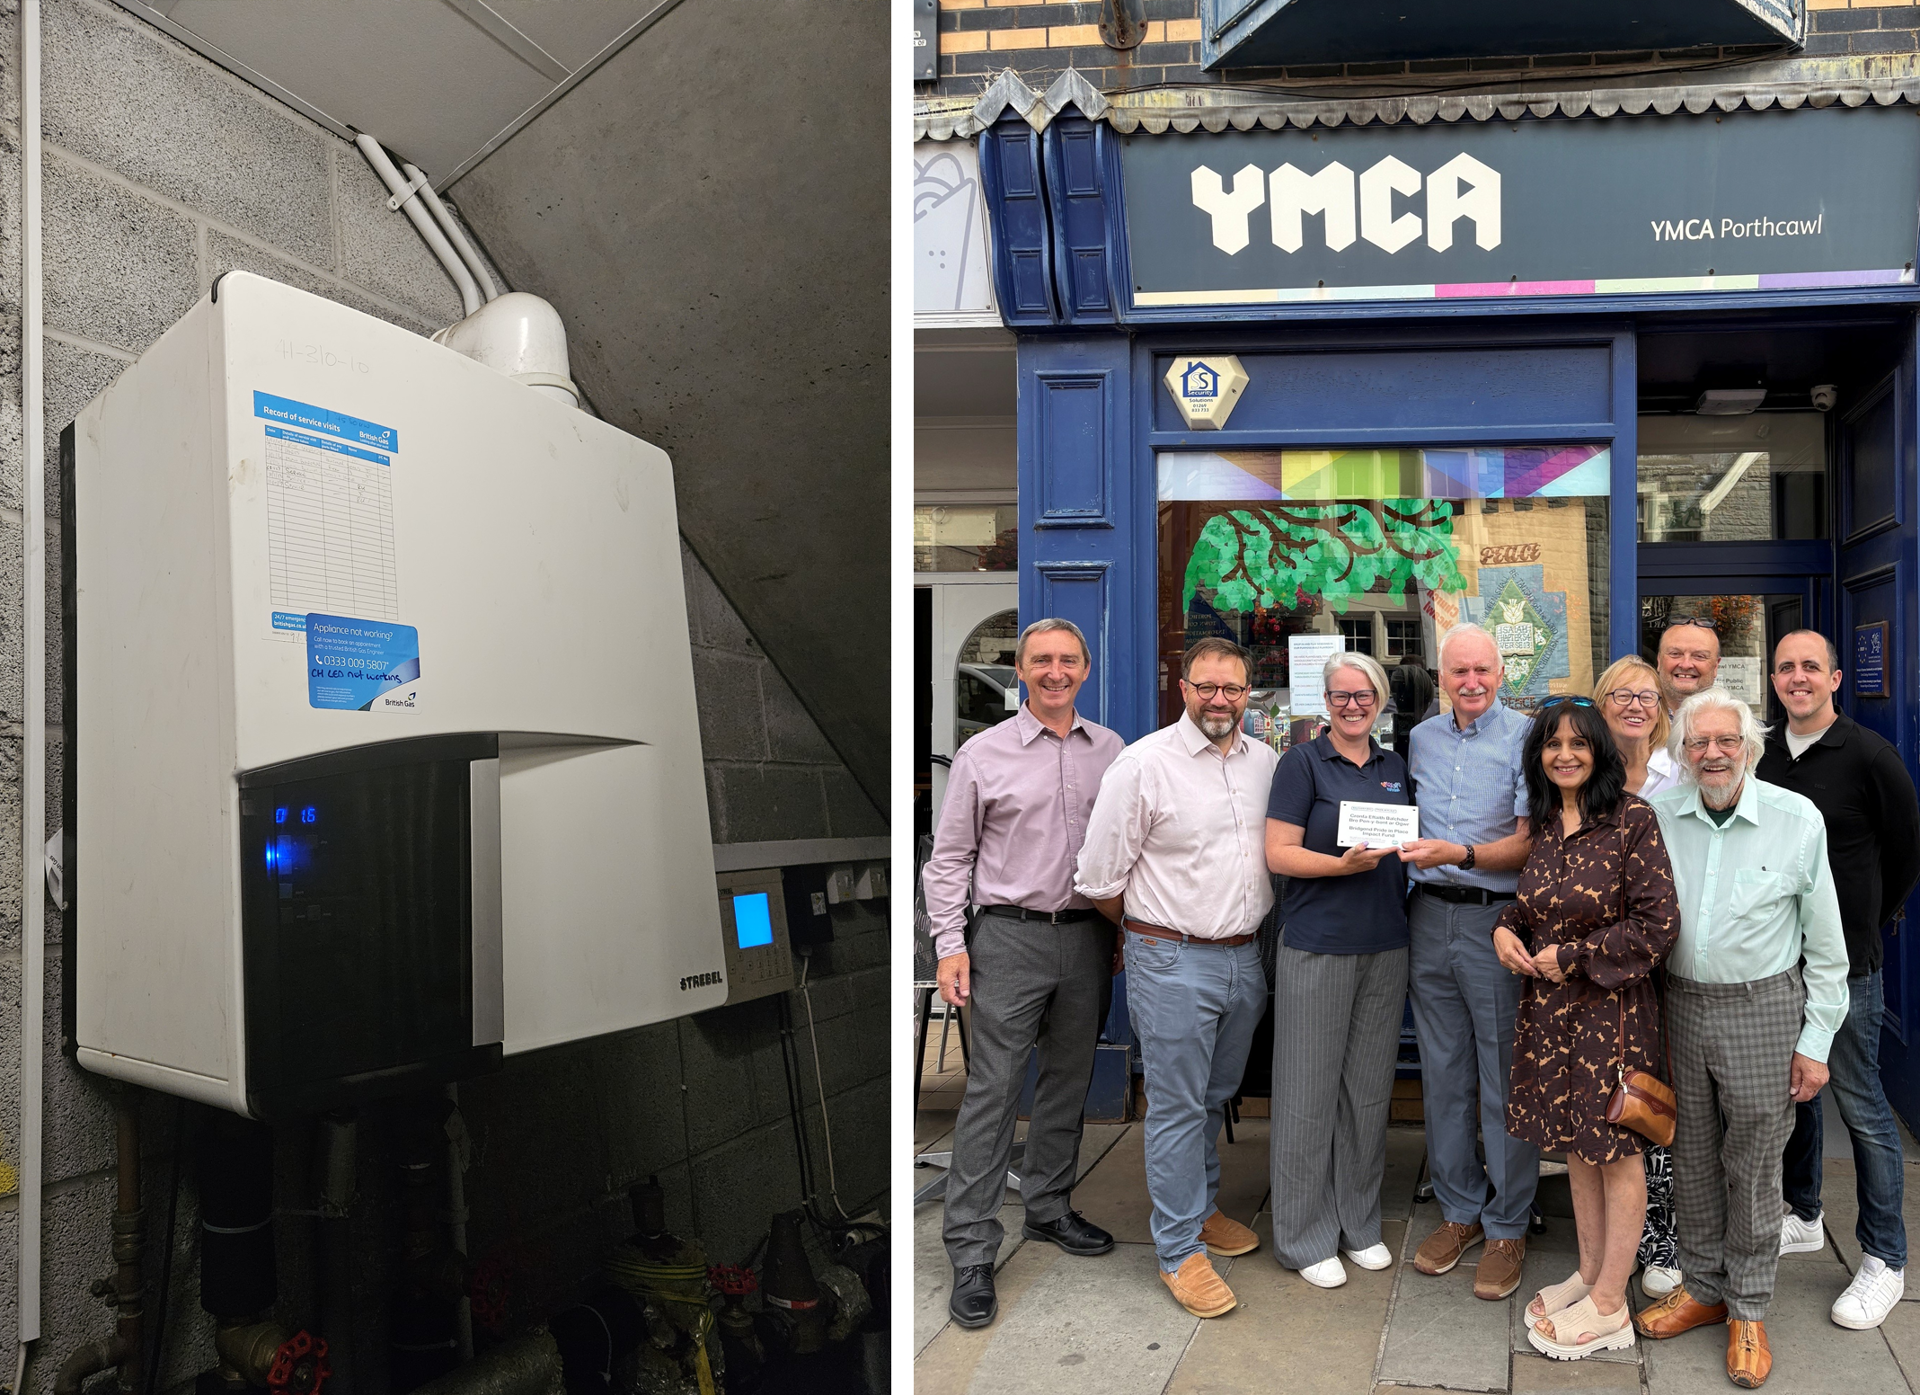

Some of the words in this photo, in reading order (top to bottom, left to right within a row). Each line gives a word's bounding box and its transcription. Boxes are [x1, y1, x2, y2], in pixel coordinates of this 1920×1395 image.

[1190, 151, 1502, 256] YMCA
[1650, 218, 1715, 242] YMCA
[1720, 213, 1823, 239] Porthcawl
[263, 406, 288, 419] Record
[298, 417, 322, 427] service
[323, 422, 340, 432] visits
[359, 431, 379, 441] British
[379, 437, 389, 445] Gas
[1480, 542, 1541, 565] PEACE
[313, 622, 349, 634] Appliance
[364, 630, 393, 641] working?
[324, 655, 346, 667] 0333
[348, 657, 364, 668] 009
[311, 668, 324, 678] CH
[347, 670, 364, 680] not
[680, 971, 723, 991] STREBEL
